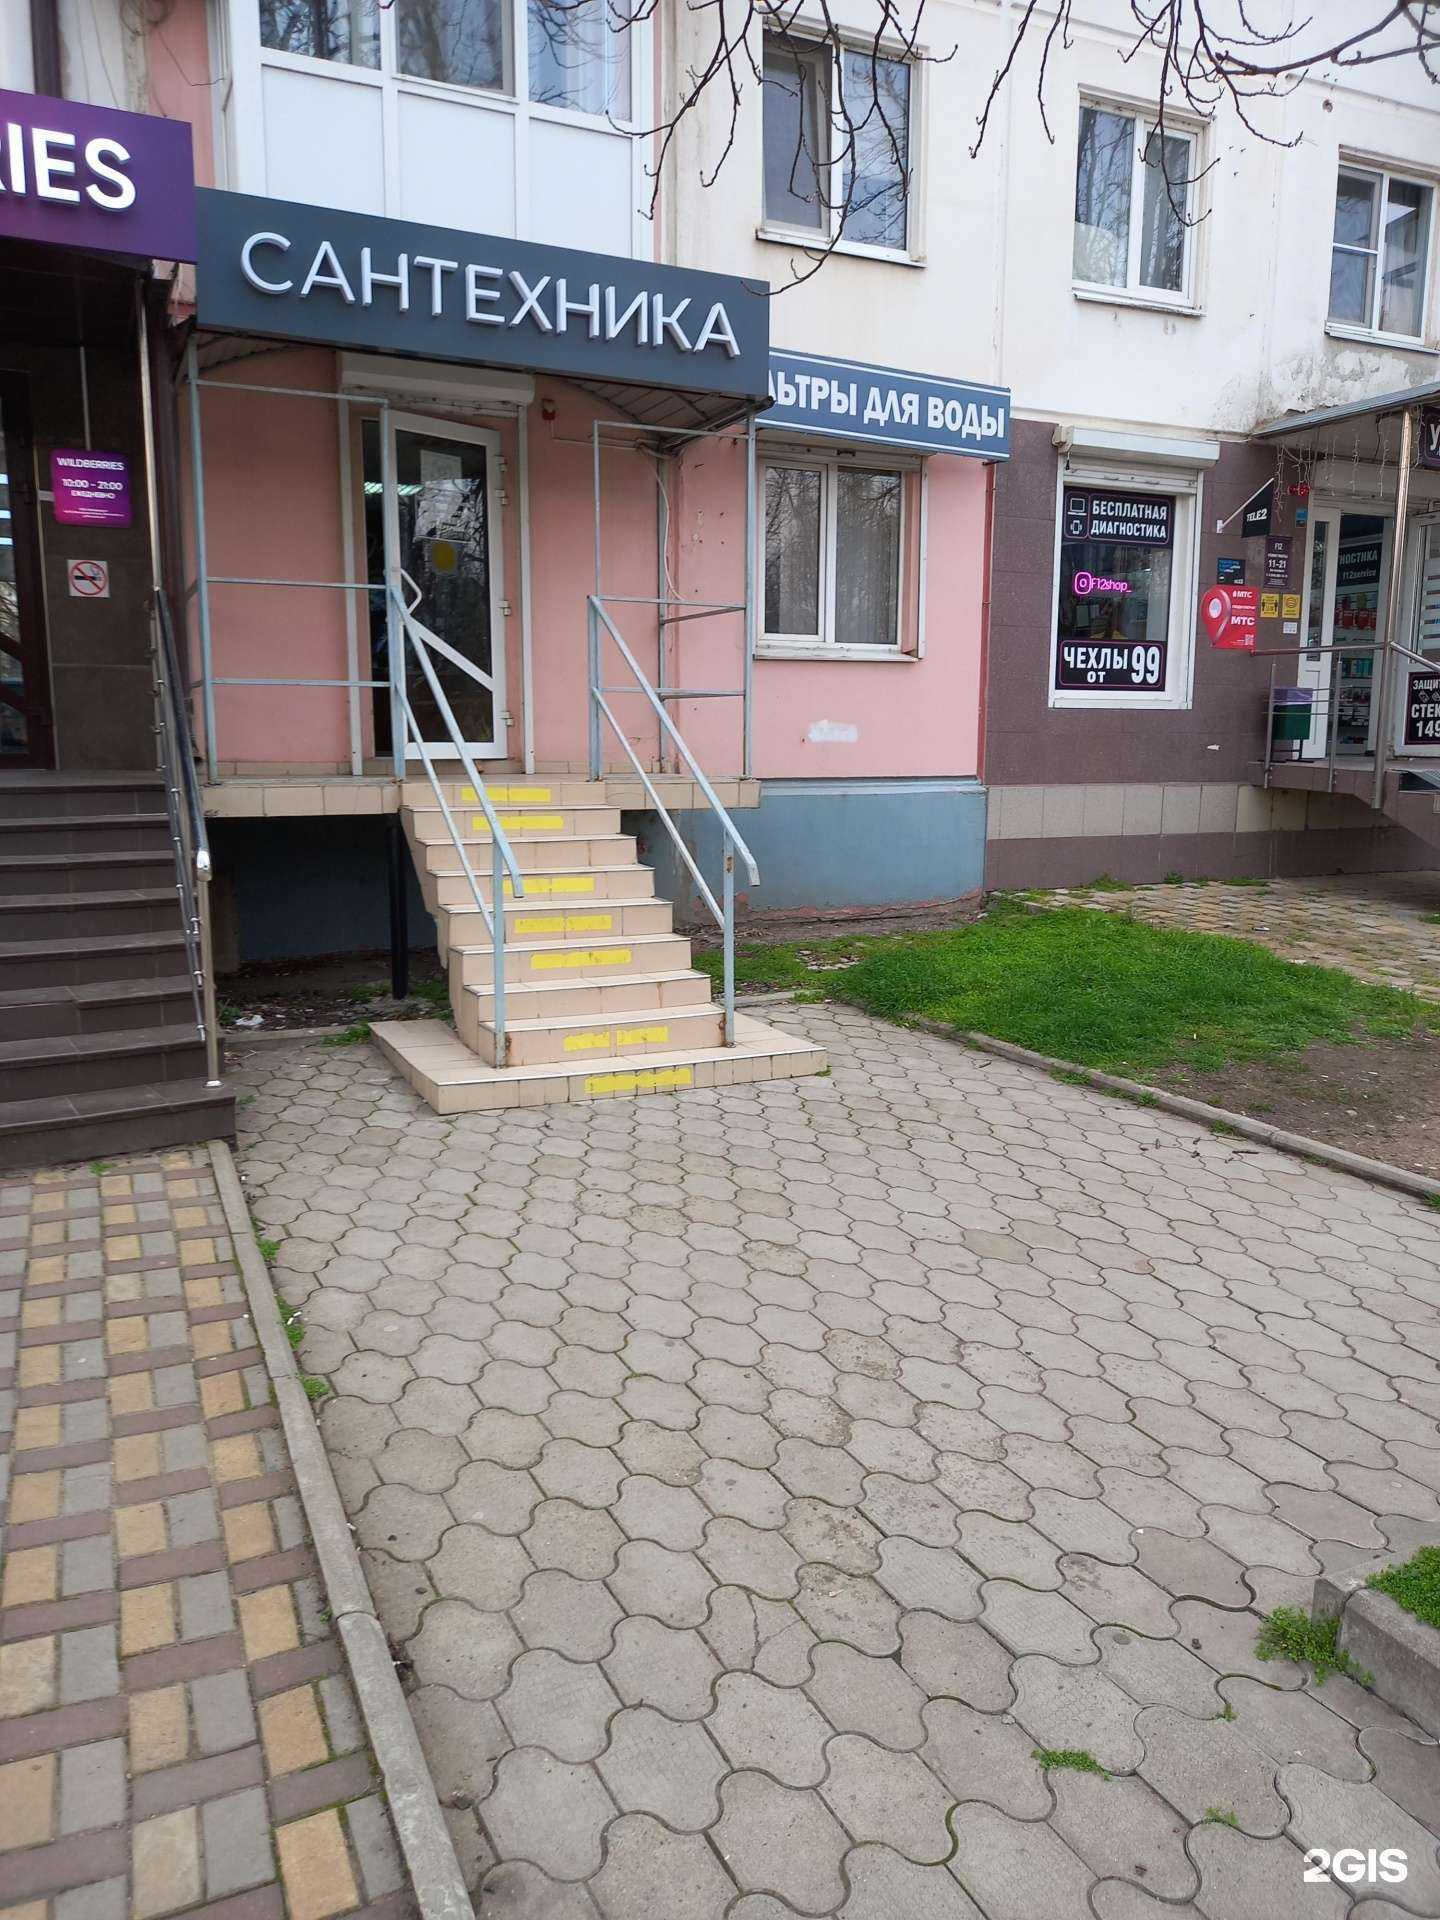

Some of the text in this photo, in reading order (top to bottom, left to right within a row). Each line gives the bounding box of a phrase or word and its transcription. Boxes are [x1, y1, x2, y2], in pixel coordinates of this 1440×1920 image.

[0, 122, 137, 212] IES
[240, 231, 741, 359] САНТЕХНИКА
[863, 386, 919, 427] ДЛЯ
[927, 396, 1005, 441] ВОДЫ
[1090, 520, 1167, 538] ДИАГНОСТИКА
[1092, 500, 1168, 520] БЕСПЛАТНАЯ
[1231, 616, 1255, 625] МТС
[1063, 645, 1160, 684] ЧЕХЛЫ 99
